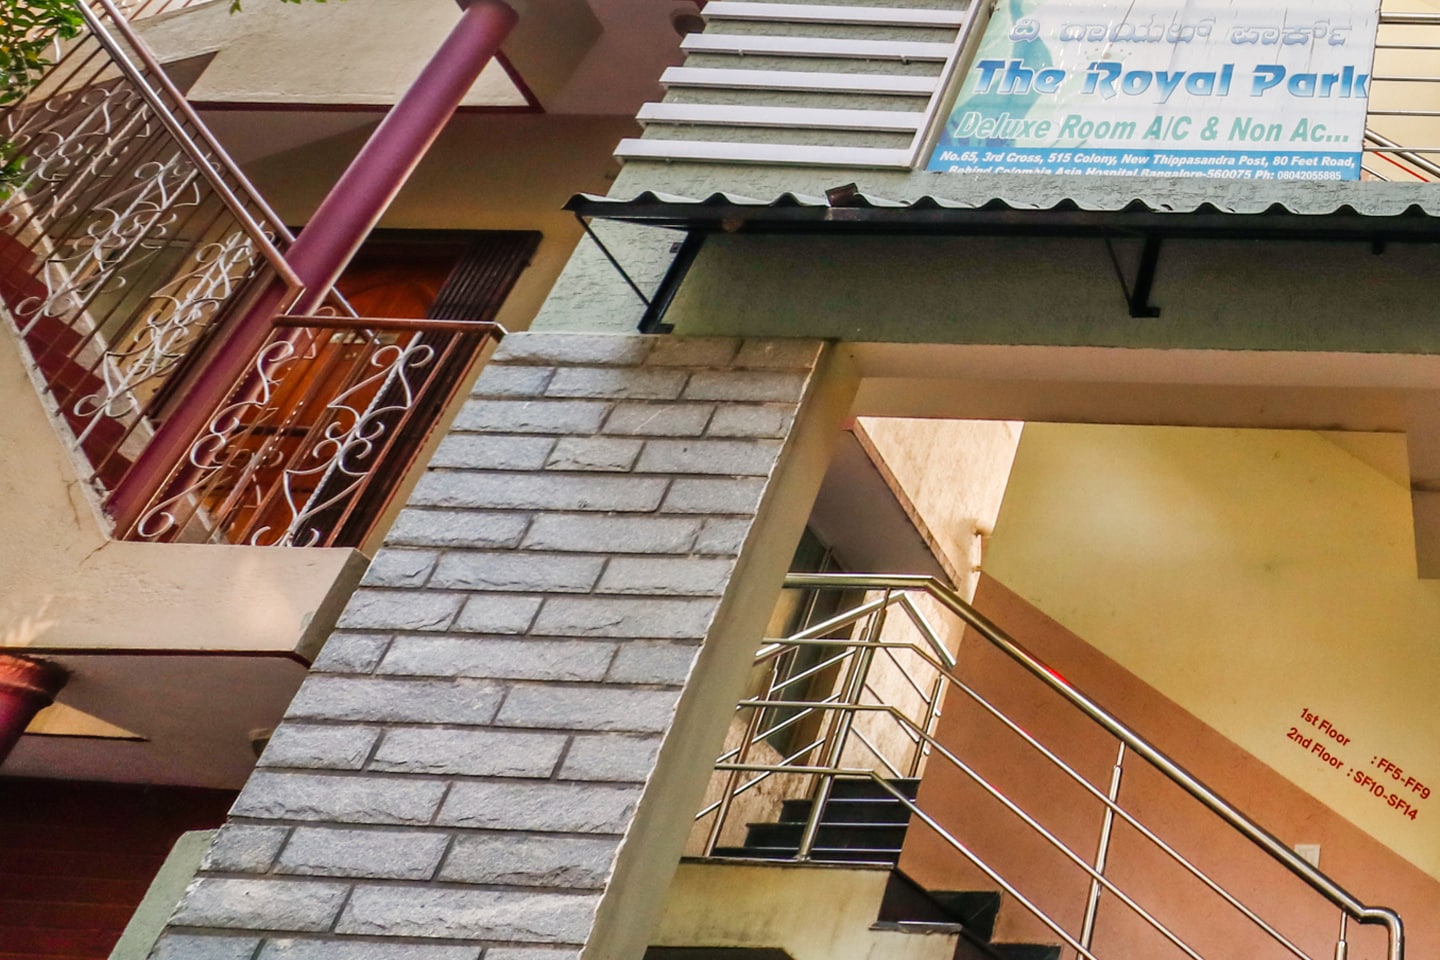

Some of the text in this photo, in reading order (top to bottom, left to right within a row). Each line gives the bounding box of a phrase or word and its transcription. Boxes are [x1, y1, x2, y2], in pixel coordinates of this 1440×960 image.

[975, 59, 1369, 104] The Royal Park
[954, 112, 1051, 139] Deluxe
[1057, 114, 1137, 140] Room
[1141, 115, 1192, 141] A/C
[1200, 116, 1219, 141] &
[1228, 117, 1283, 142] Non
[939, 151, 1355, 169] No.65, 3rd Cross, 515 Colony, New Thippasandra Post, 80 Feet Road,
[1254, 169, 1274, 180] Ph:
[1300, 707, 1319, 727] 1st
[1318, 720, 1351, 747] Floor
[1286, 727, 1313, 749] 2nd
[1311, 742, 1344, 770] Floor
